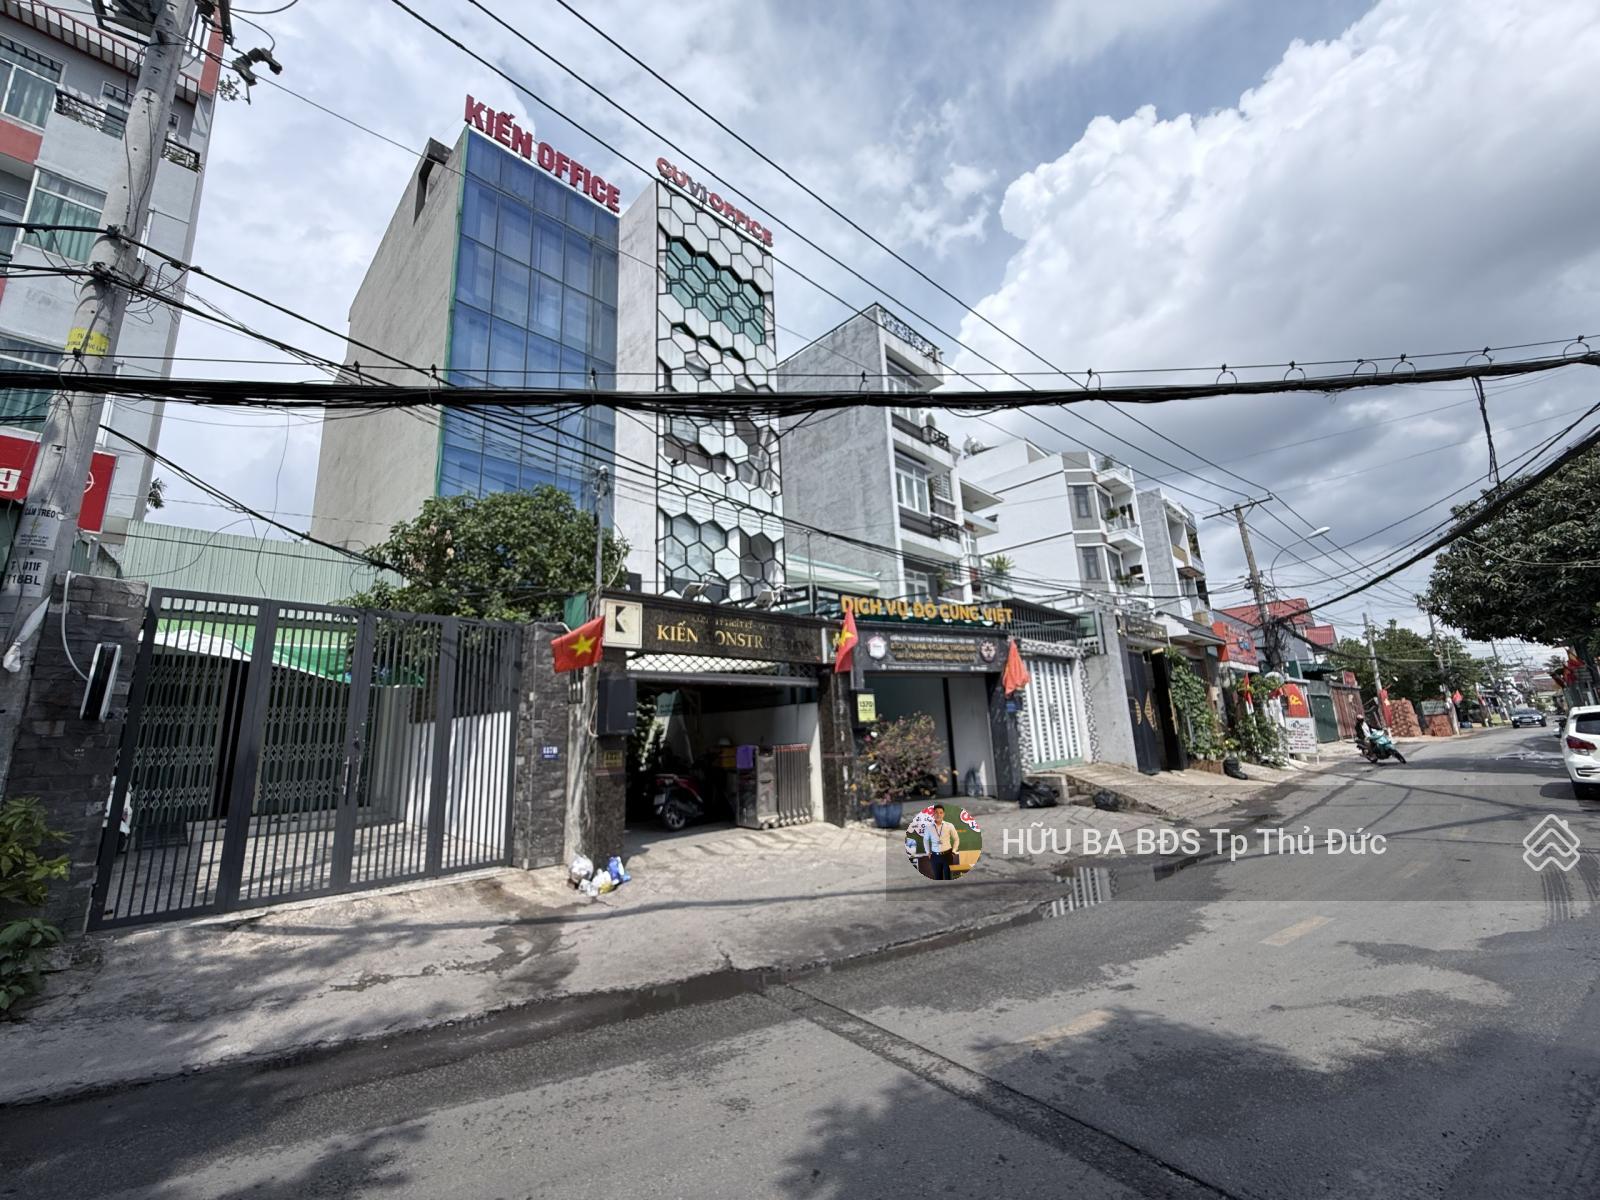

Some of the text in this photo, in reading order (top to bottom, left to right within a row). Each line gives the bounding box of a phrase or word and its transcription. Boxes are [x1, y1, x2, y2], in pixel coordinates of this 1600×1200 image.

[464, 94, 620, 213] KIẾN OFFICE
[708, 191, 774, 248] OFFICE
[656, 620, 699, 644] KIẾN
